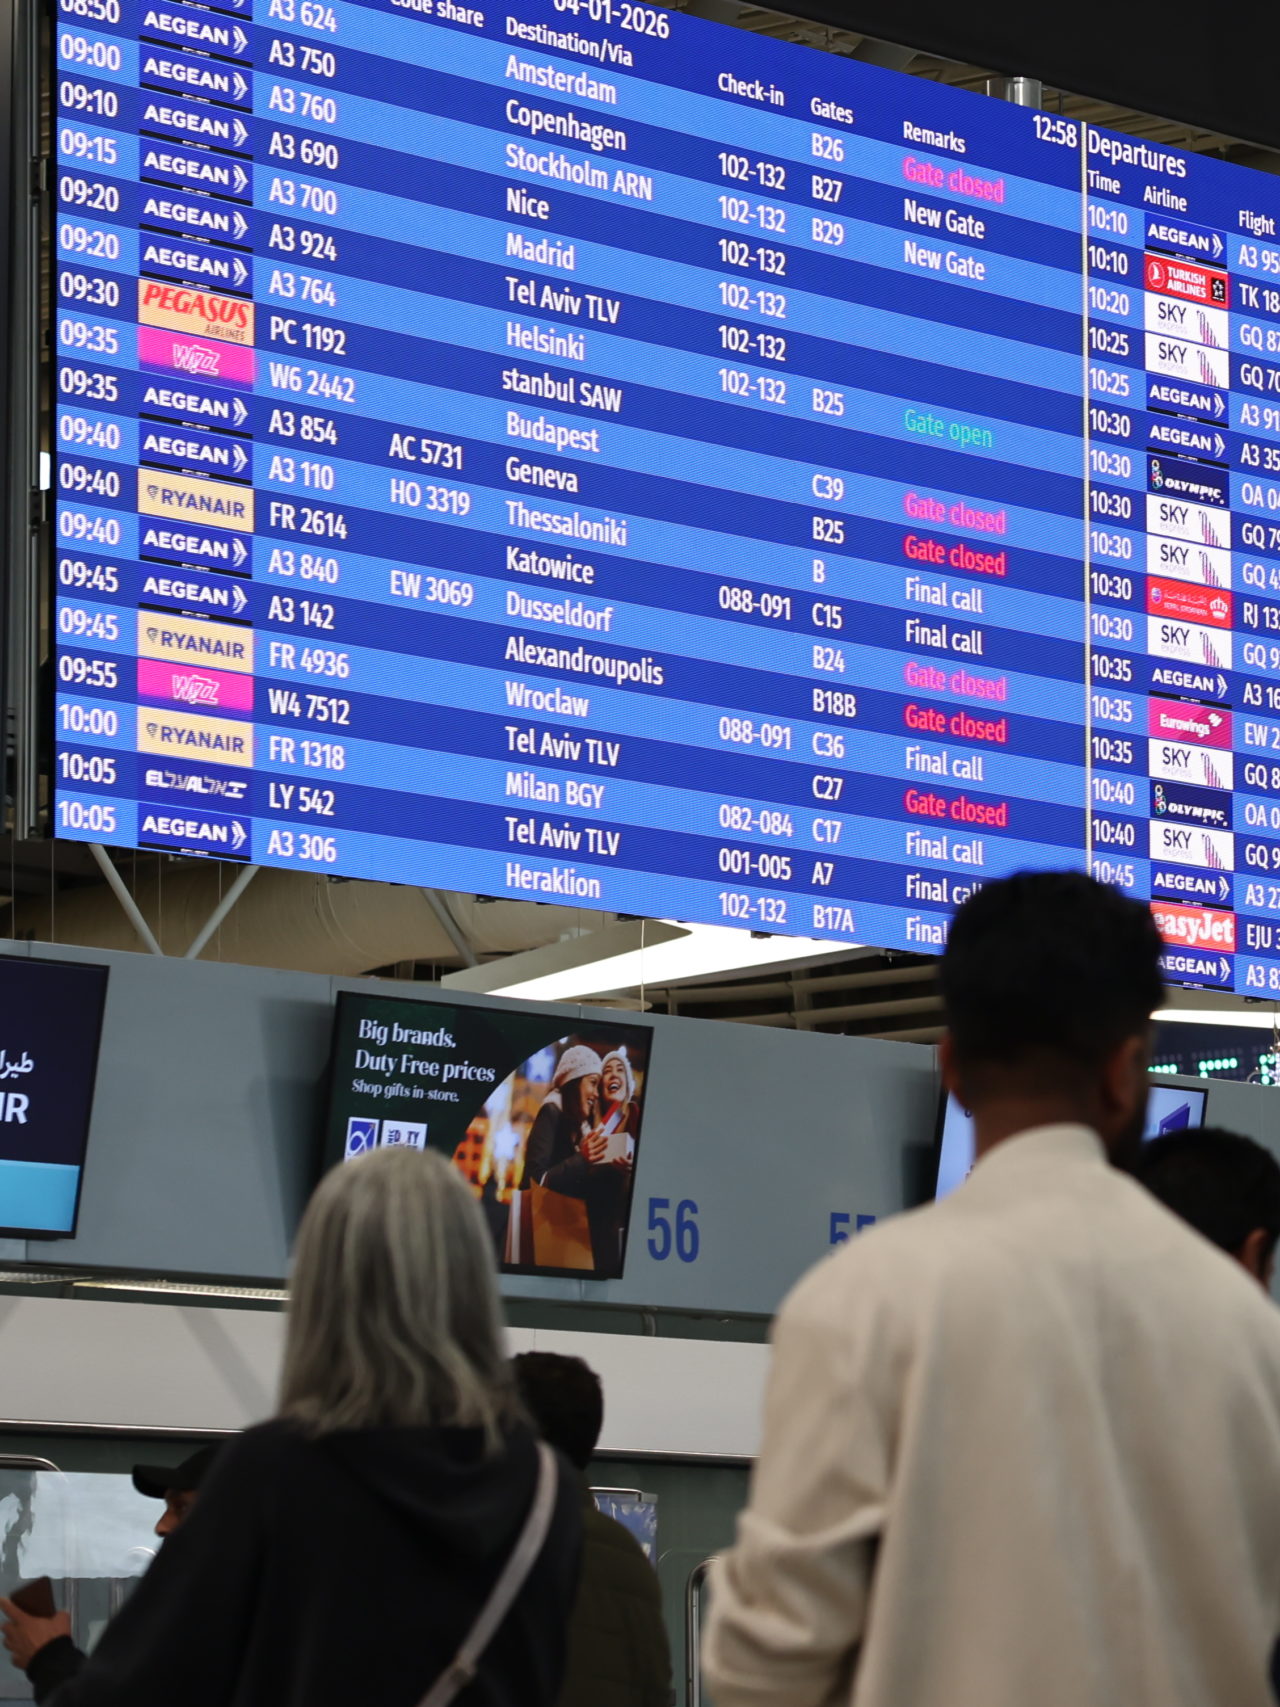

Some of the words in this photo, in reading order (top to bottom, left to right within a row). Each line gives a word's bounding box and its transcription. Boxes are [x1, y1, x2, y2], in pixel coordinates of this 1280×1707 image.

[144, 11, 228, 45] AEGEAN
[437, 0, 484, 27] share
[60, 34, 121, 71] 09:00
[269, 40, 295, 67] A3
[300, 46, 335, 77] 750
[507, 17, 632, 66] Destination/Via
[505, 55, 616, 104] Amsterdam
[718, 73, 784, 106] Check-in
[61, 82, 117, 117] 09:10
[811, 98, 853, 123] Gates
[507, 100, 626, 151] Copenhagen
[904, 121, 965, 153] Remarks
[1033, 115, 1077, 147] 12:58
[60, 129, 117, 164] 09:15
[812, 133, 844, 162] B26
[1088, 129, 1187, 178] Departures
[506, 143, 608, 190] Stockholm
[613, 170, 652, 200] ARN
[719, 153, 785, 190] 102-132
[903, 156, 944, 189] Gate
[948, 168, 1006, 204] closed
[1088, 169, 1121, 195] Time
[507, 188, 549, 219] Nice
[1144, 186, 1187, 211] Airline
[905, 199, 941, 228] New
[946, 210, 984, 239] Gate
[1088, 204, 1128, 235] 10:10
[1239, 211, 1275, 235] Flight
[506, 232, 575, 270] Madrid
[60, 272, 119, 306] 09:30
[1167, 265, 1206, 286] TURKISH
[1167, 279, 1207, 299] AIRLINES
[143, 284, 248, 329] PEGASUS
[1089, 285, 1130, 316] 10:20
[1157, 301, 1188, 325] SKY
[1240, 284, 1259, 308] TK
[271, 316, 297, 344] PC
[303, 324, 345, 355] 1192
[507, 322, 584, 361] Helsinki
[269, 362, 302, 392] W6
[307, 370, 355, 403] 2442
[507, 411, 600, 453] Budapest
[389, 434, 416, 460] AC
[421, 439, 461, 469] 5731
[506, 457, 578, 492] Geneva
[161, 483, 245, 519] RYANAIR
[271, 502, 295, 529] FR
[301, 508, 347, 539] 2614
[505, 500, 627, 546] Thessaloniki
[507, 546, 594, 584] Katowice
[719, 586, 790, 620] 088-091
[906, 619, 947, 648] Final
[952, 630, 982, 655] call
[60, 656, 117, 688] 09:55
[505, 637, 663, 685] Alexandroupolis
[505, 681, 589, 717] Wroclaw
[813, 689, 856, 717] B18B
[1159, 713, 1210, 737] Eurowings
[59, 753, 116, 784] 10:05
[270, 783, 294, 809] LY
[299, 787, 334, 815] 542
[506, 771, 560, 803] Milan
[566, 780, 605, 809] BGY
[142, 816, 227, 842] AEGEAN
[506, 862, 601, 898] Heraklion
[358, 1019, 388, 1046] Big
[392, 1022, 457, 1048] brands.
[354, 1049, 398, 1077] Duty
[400, 1054, 439, 1076] Free
[442, 1060, 495, 1083] prices
[351, 1078, 382, 1098] Shop
[384, 1083, 411, 1099] gifts
[412, 1085, 460, 1102] in-store.
[647, 1197, 699, 1263] 56
